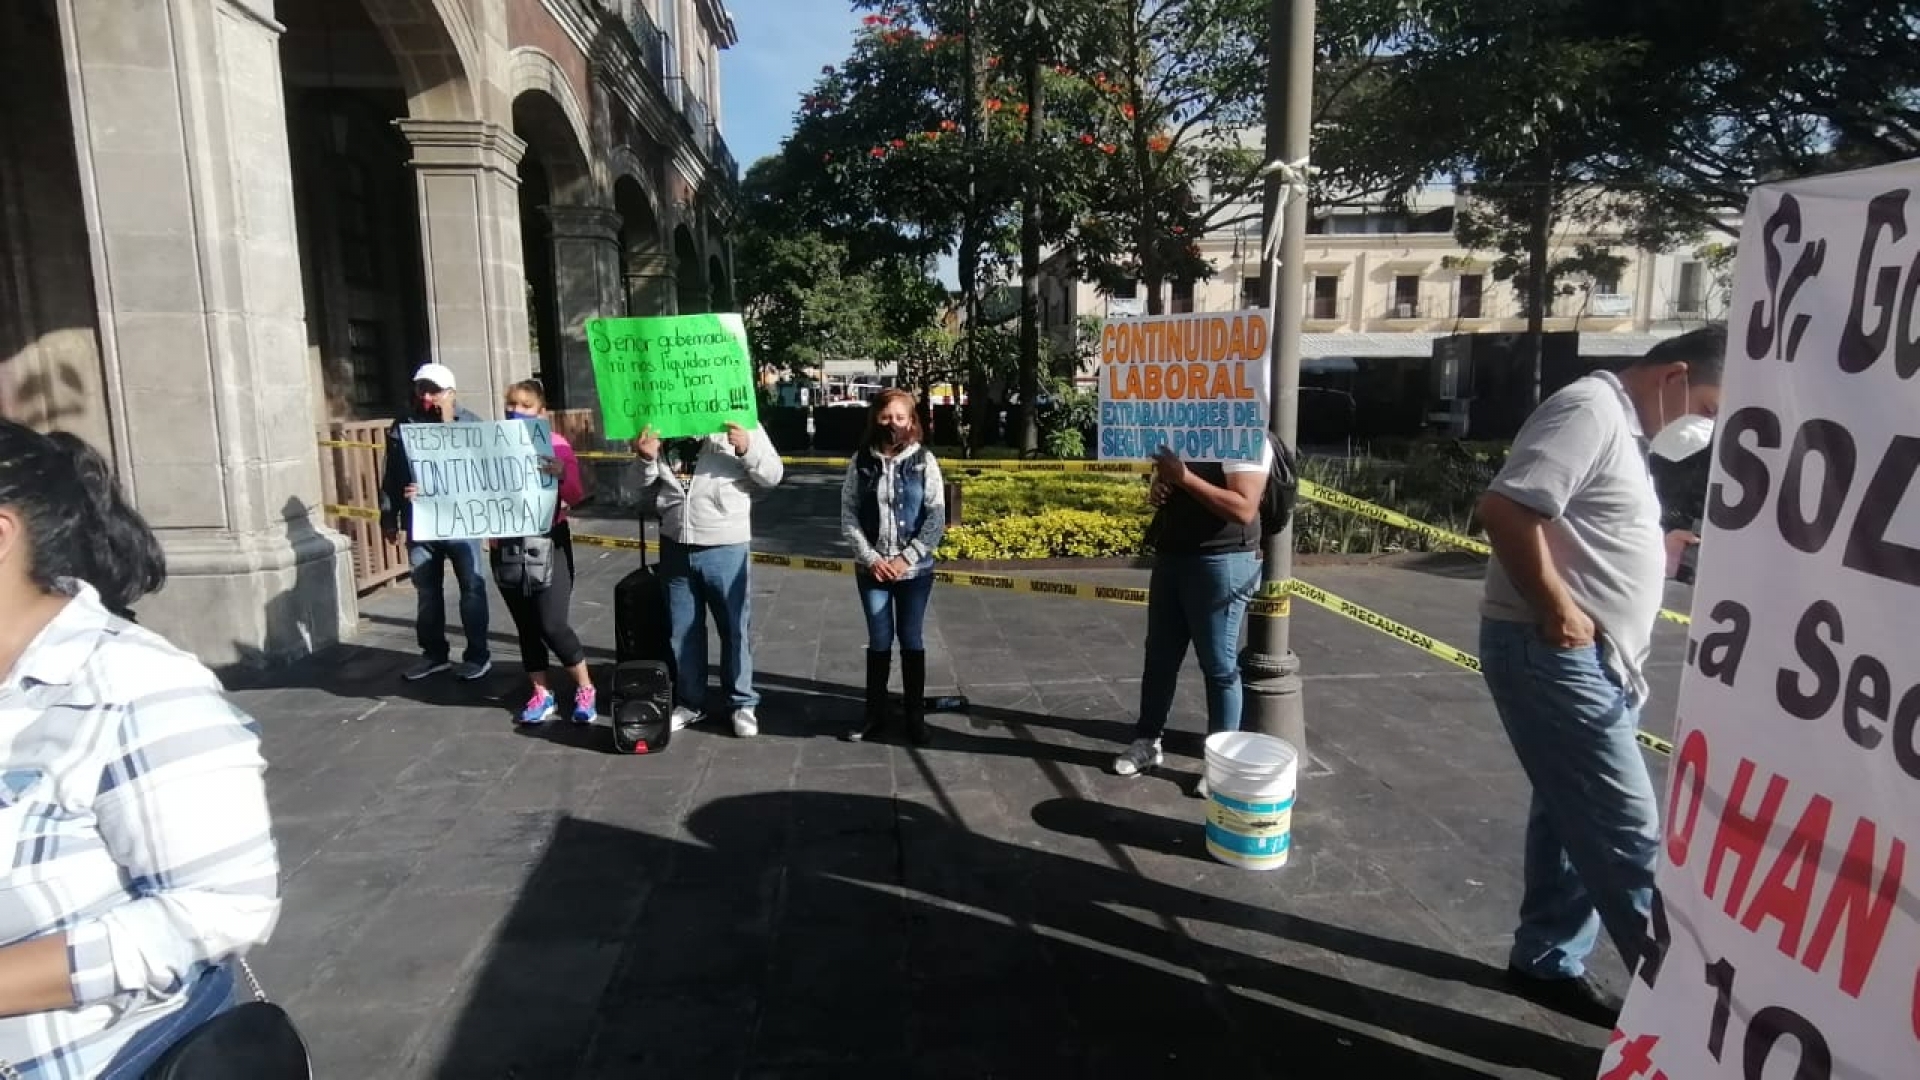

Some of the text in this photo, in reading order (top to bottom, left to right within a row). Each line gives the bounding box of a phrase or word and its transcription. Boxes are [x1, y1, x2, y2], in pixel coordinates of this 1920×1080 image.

[591, 320, 651, 353] Señor
[1102, 315, 1267, 364] CONTINUIDAD
[610, 356, 625, 373] ni
[631, 360, 656, 373] nos
[649, 379, 675, 391] nos
[682, 369, 713, 389] han
[1110, 363, 1254, 399] LABORAL
[1102, 401, 1264, 427] EXTRABAJADORES DEL
[405, 422, 547, 450] RESPETO A LA
[1173, 428, 1264, 460] POPULAR
[410, 455, 553, 497] CONTINUIDAD
[435, 496, 550, 537] LABORAL
[1340, 602, 1434, 650] PRECAUCION
[1703, 757, 1906, 999] HAN
